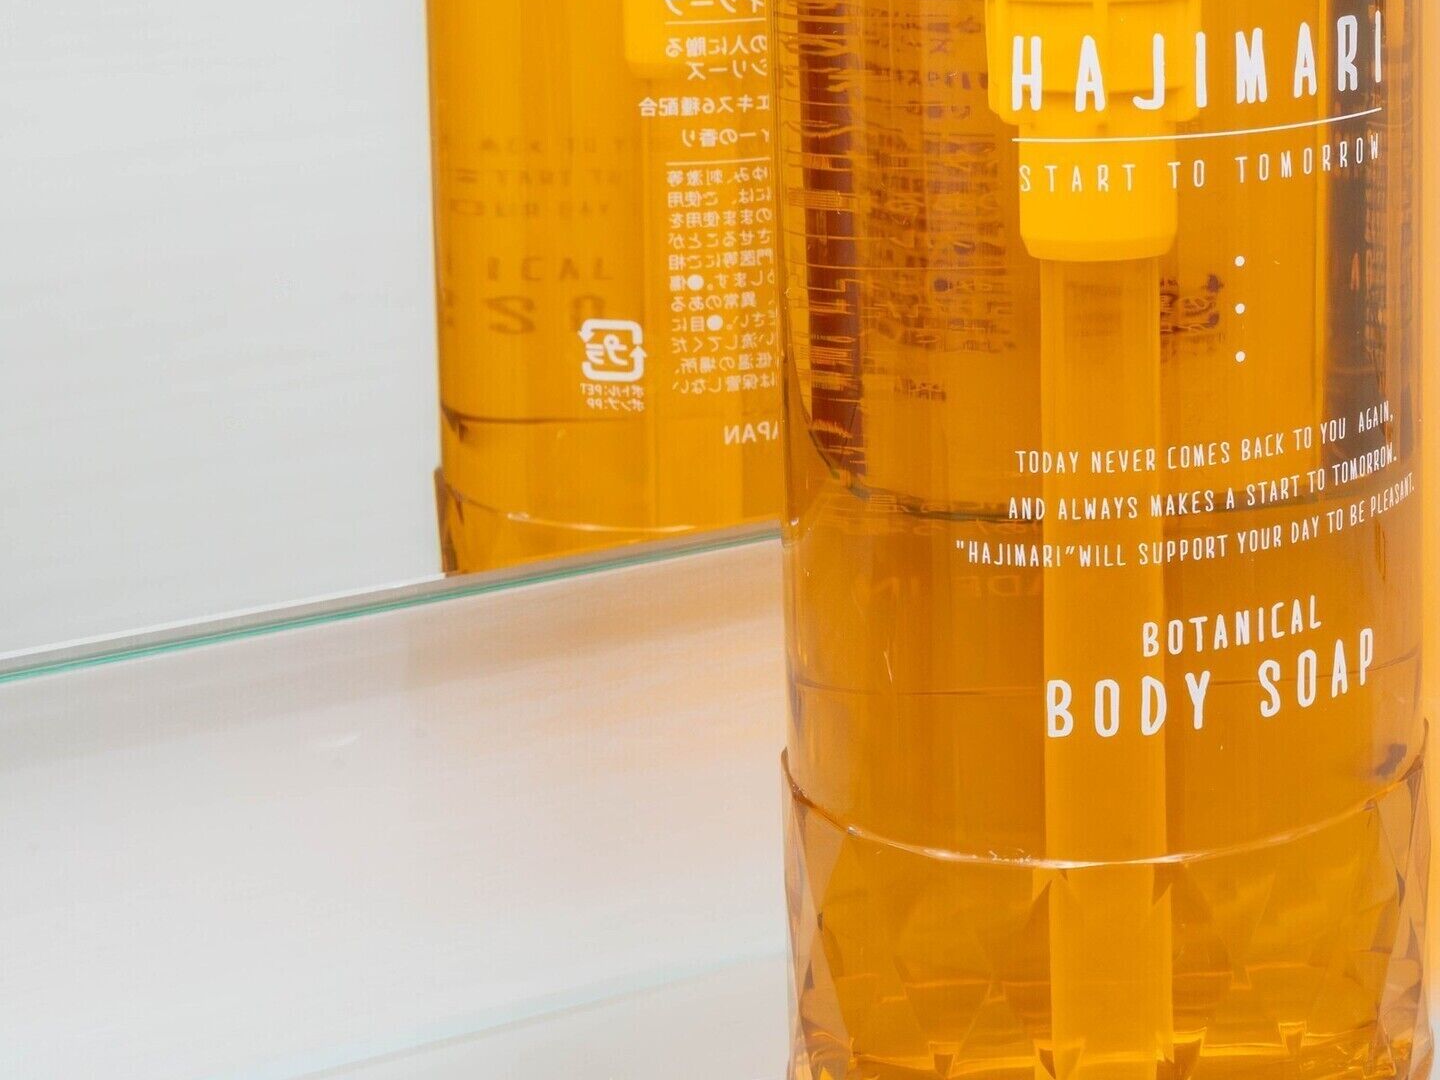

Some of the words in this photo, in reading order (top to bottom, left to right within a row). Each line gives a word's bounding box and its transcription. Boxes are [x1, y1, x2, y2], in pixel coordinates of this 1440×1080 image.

[1011, 10, 1382, 112] HAJIMARI
[1019, 163, 1137, 193] START
[1167, 159, 1205, 190] TO
[1235, 133, 1380, 184] TOMORROW
[1015, 450, 1079, 474] TODAY
[1091, 449, 1157, 473] NEVER
[1167, 440, 1231, 469] COMES
[1241, 432, 1285, 461] BACK
[1293, 426, 1312, 451] TO
[1320, 417, 1346, 445] YOU
[1358, 400, 1394, 433] AGAIN,
[1008, 496, 1046, 521] AND
[1057, 496, 1138, 521] ALWAYS
[1150, 489, 1215, 517] MAKES
[1225, 486, 1236, 510] A
[1246, 475, 1300, 508] START
[1307, 468, 1325, 494] TO
[1332, 442, 1397, 486] TOMORROW.
[1138, 535, 1228, 565] SUPPORT
[1236, 524, 1282, 554] YOUR
[1291, 515, 1319, 544] DAY
[1327, 508, 1343, 533] TO
[1350, 500, 1365, 527] BE
[1370, 472, 1414, 517] PLEASANT.
[1142, 594, 1322, 658] BOTANICAL
[1046, 670, 1211, 739] BODY
[1257, 627, 1374, 718] SOAP
